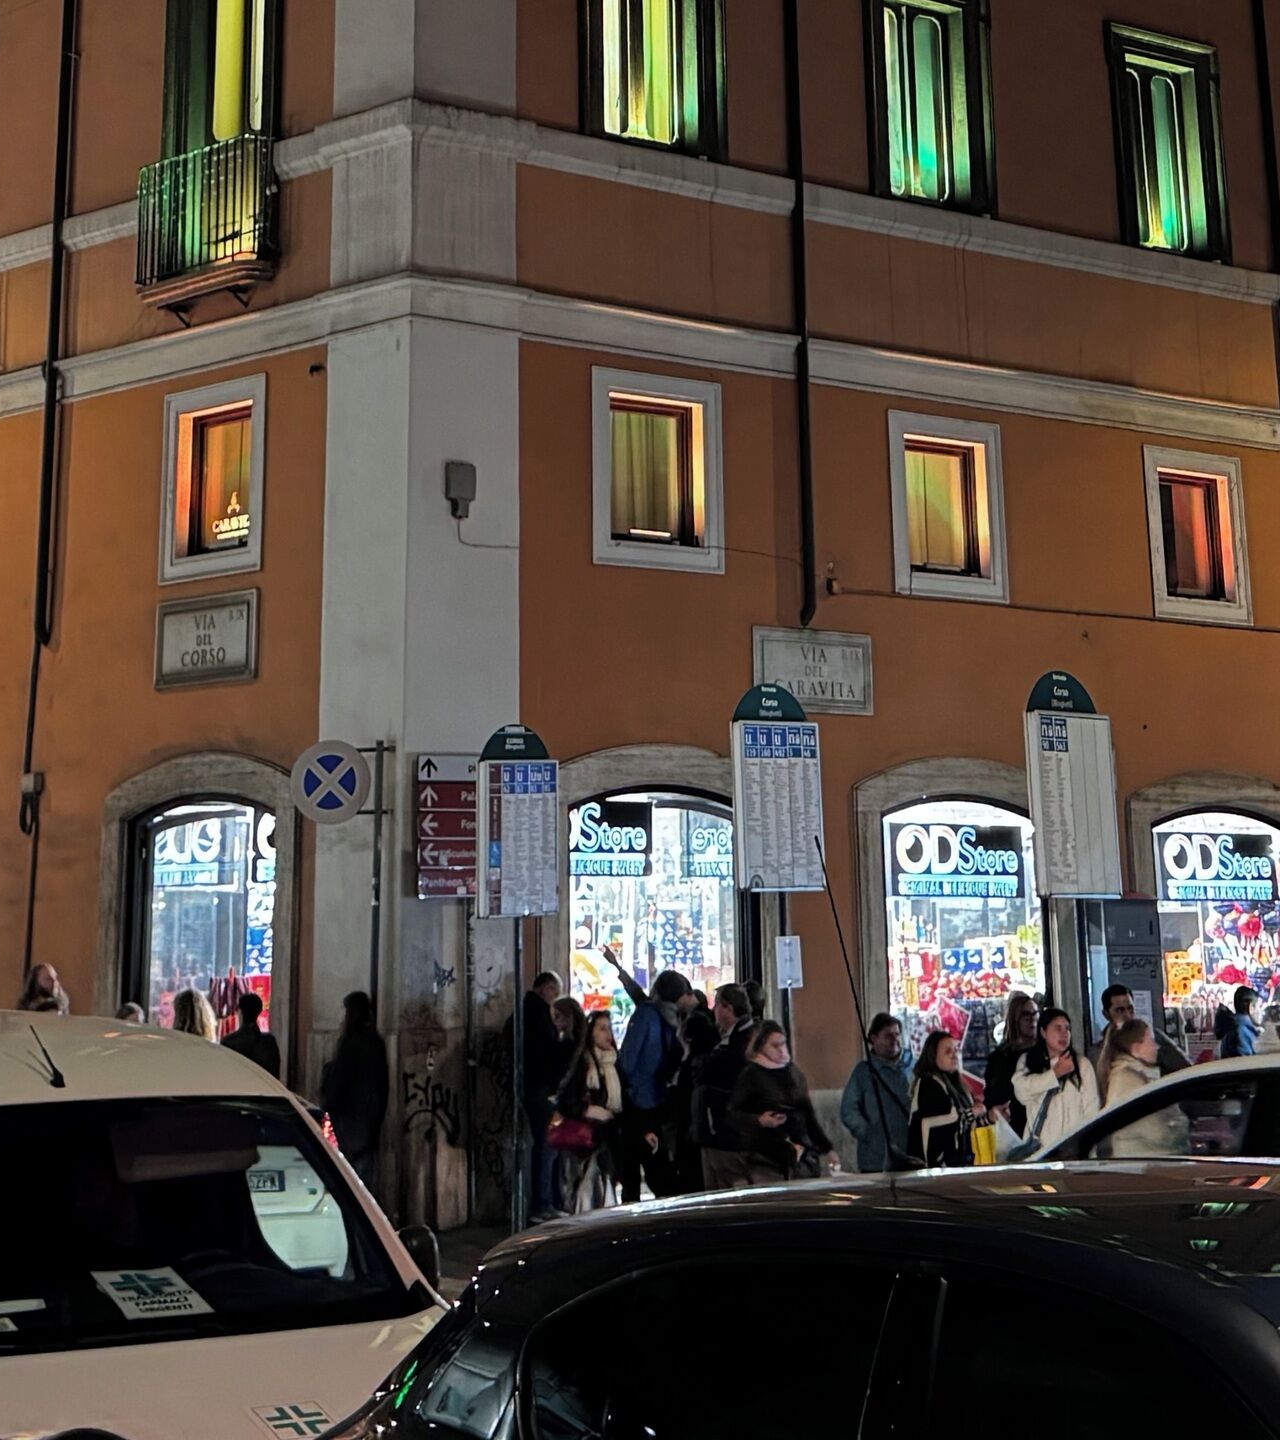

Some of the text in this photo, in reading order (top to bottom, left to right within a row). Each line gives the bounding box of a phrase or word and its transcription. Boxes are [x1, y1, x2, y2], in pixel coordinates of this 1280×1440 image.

[194, 614, 216, 631] VIA
[196, 633, 213, 647] DEL
[181, 647, 226, 667] CORSO
[800, 645, 828, 664] VIA
[804, 665, 825, 679] DEL
[422, 877, 464, 888] Pantheon
[135, 1296, 188, 1306] FARMACI
[138, 1304, 193, 1313] URGENTI
